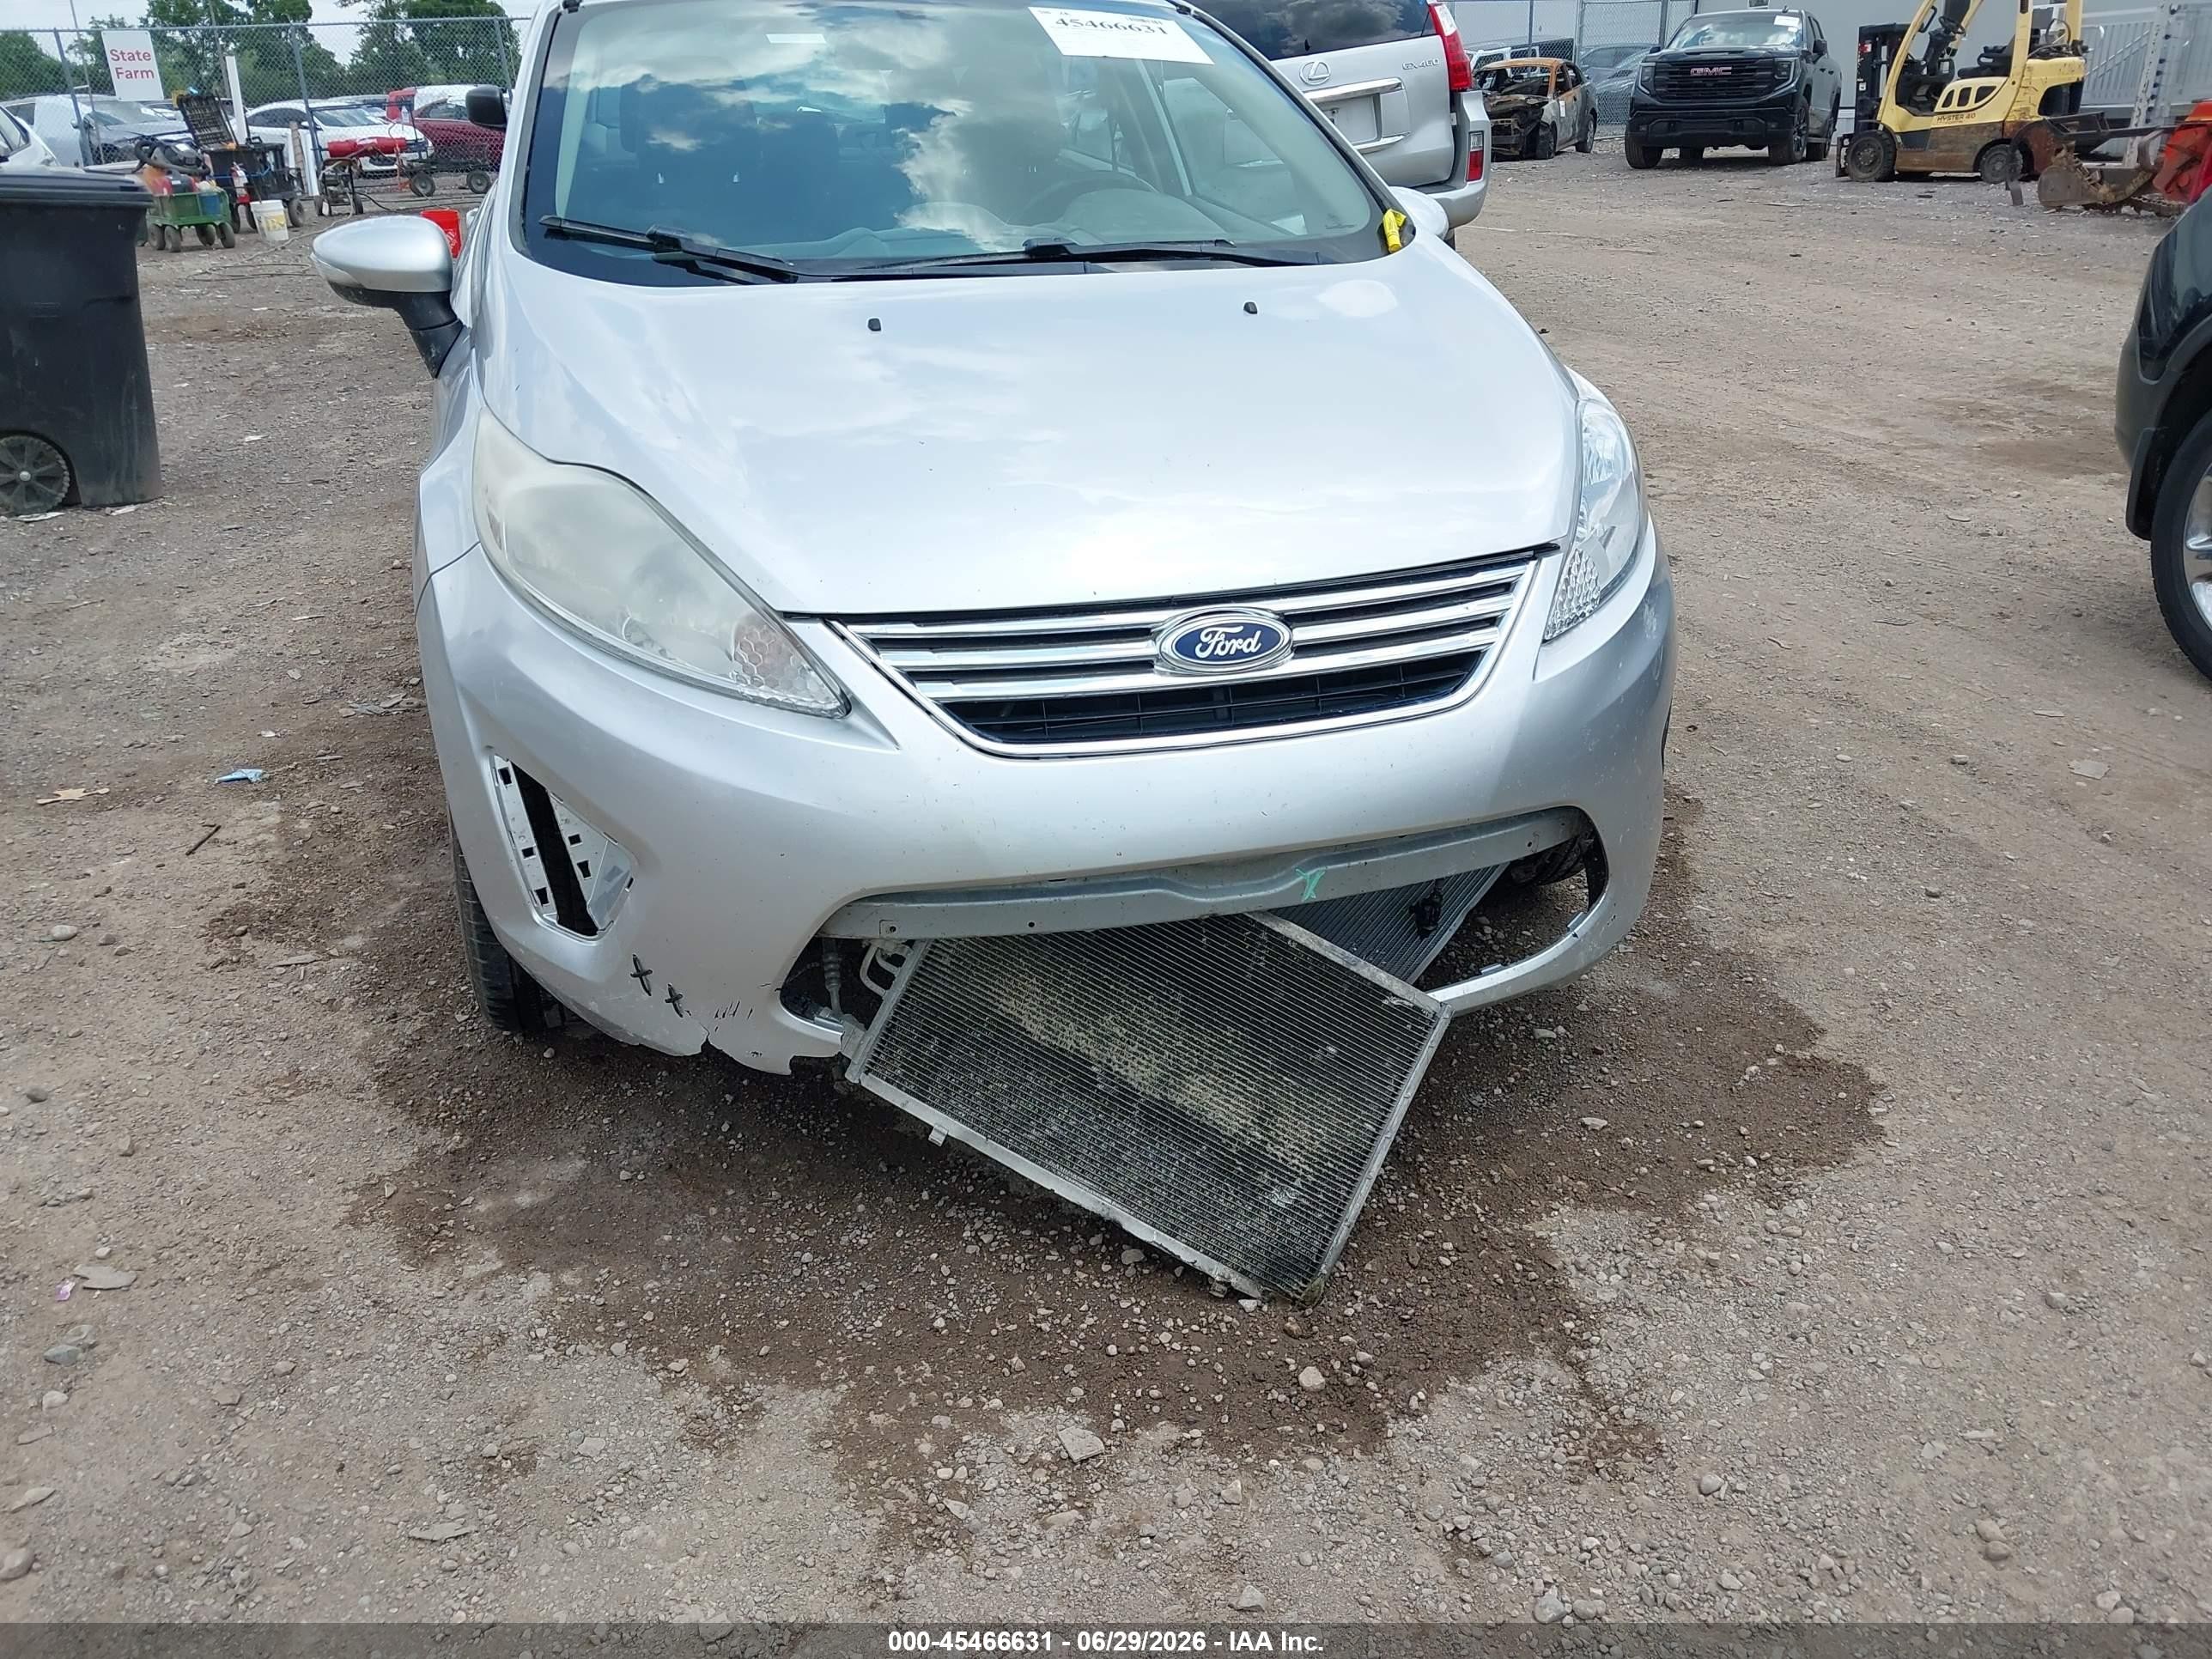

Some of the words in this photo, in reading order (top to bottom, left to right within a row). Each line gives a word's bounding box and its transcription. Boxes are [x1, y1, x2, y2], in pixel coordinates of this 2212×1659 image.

[1055, 18, 1169, 34] 45466631
[109, 48, 152, 62] State
[1418, 58, 1440, 68] 460
[114, 67, 155, 79] Farm
[1690, 66, 1733, 76] GMC
[1194, 625, 1262, 659] Ford
